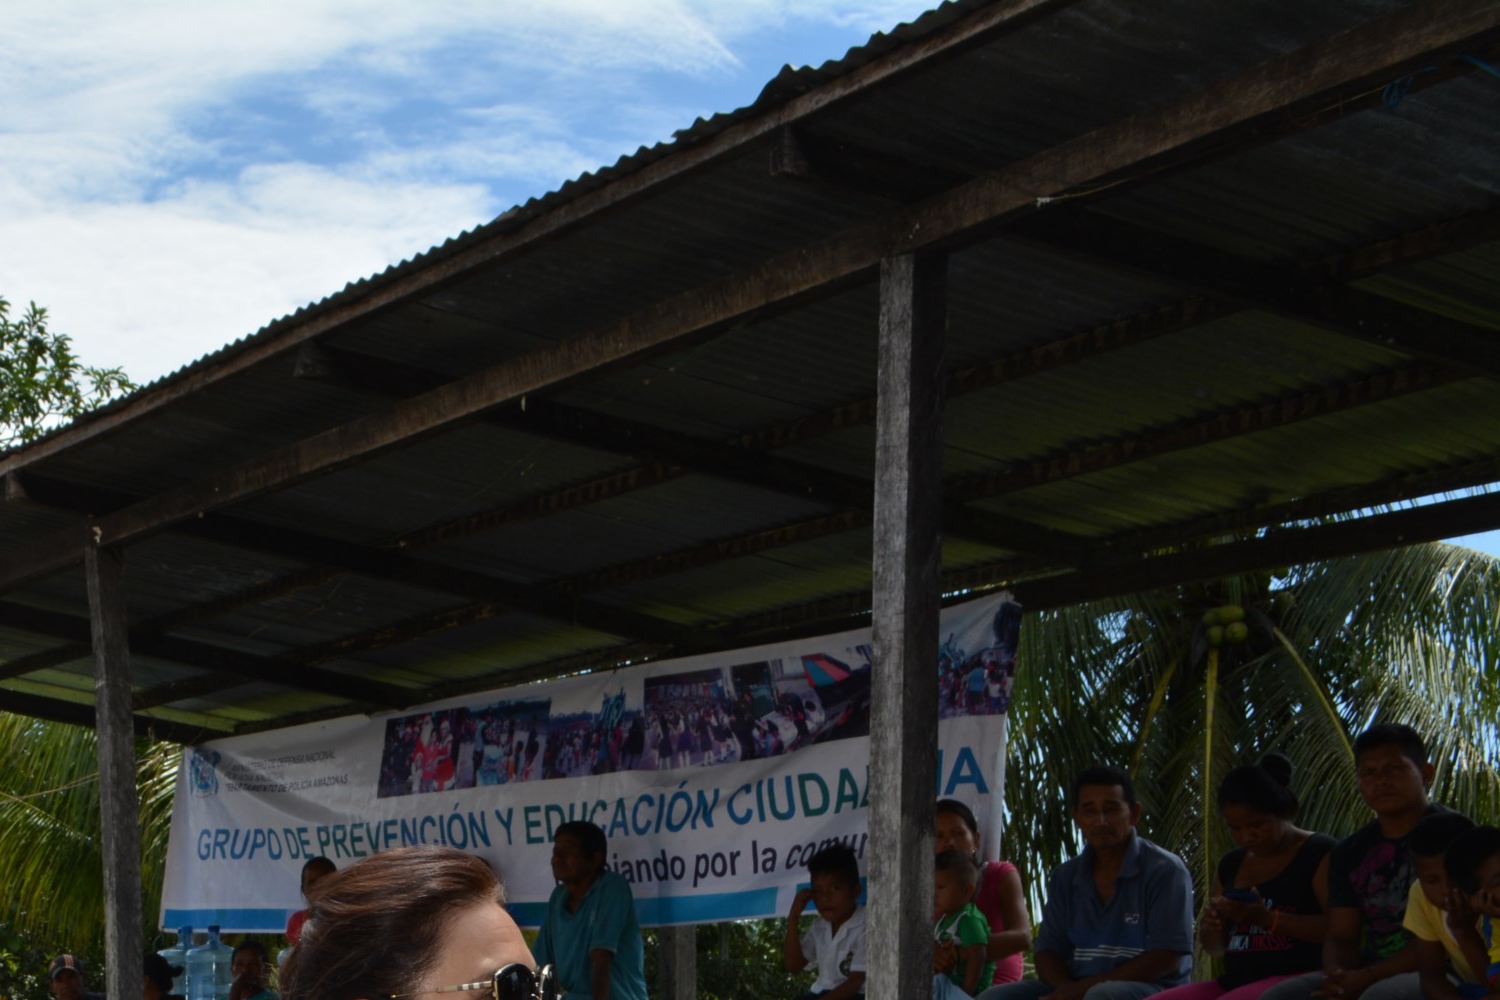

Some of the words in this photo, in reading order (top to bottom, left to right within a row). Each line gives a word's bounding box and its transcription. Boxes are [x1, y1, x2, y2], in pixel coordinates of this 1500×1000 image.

[197, 828, 282, 861] GRUPO
[283, 827, 315, 859] DE
[317, 802, 491, 859] PREVENCIÓN
[495, 808, 514, 845] Y
[693, 850, 740, 888] por
[752, 840, 776, 874] la
